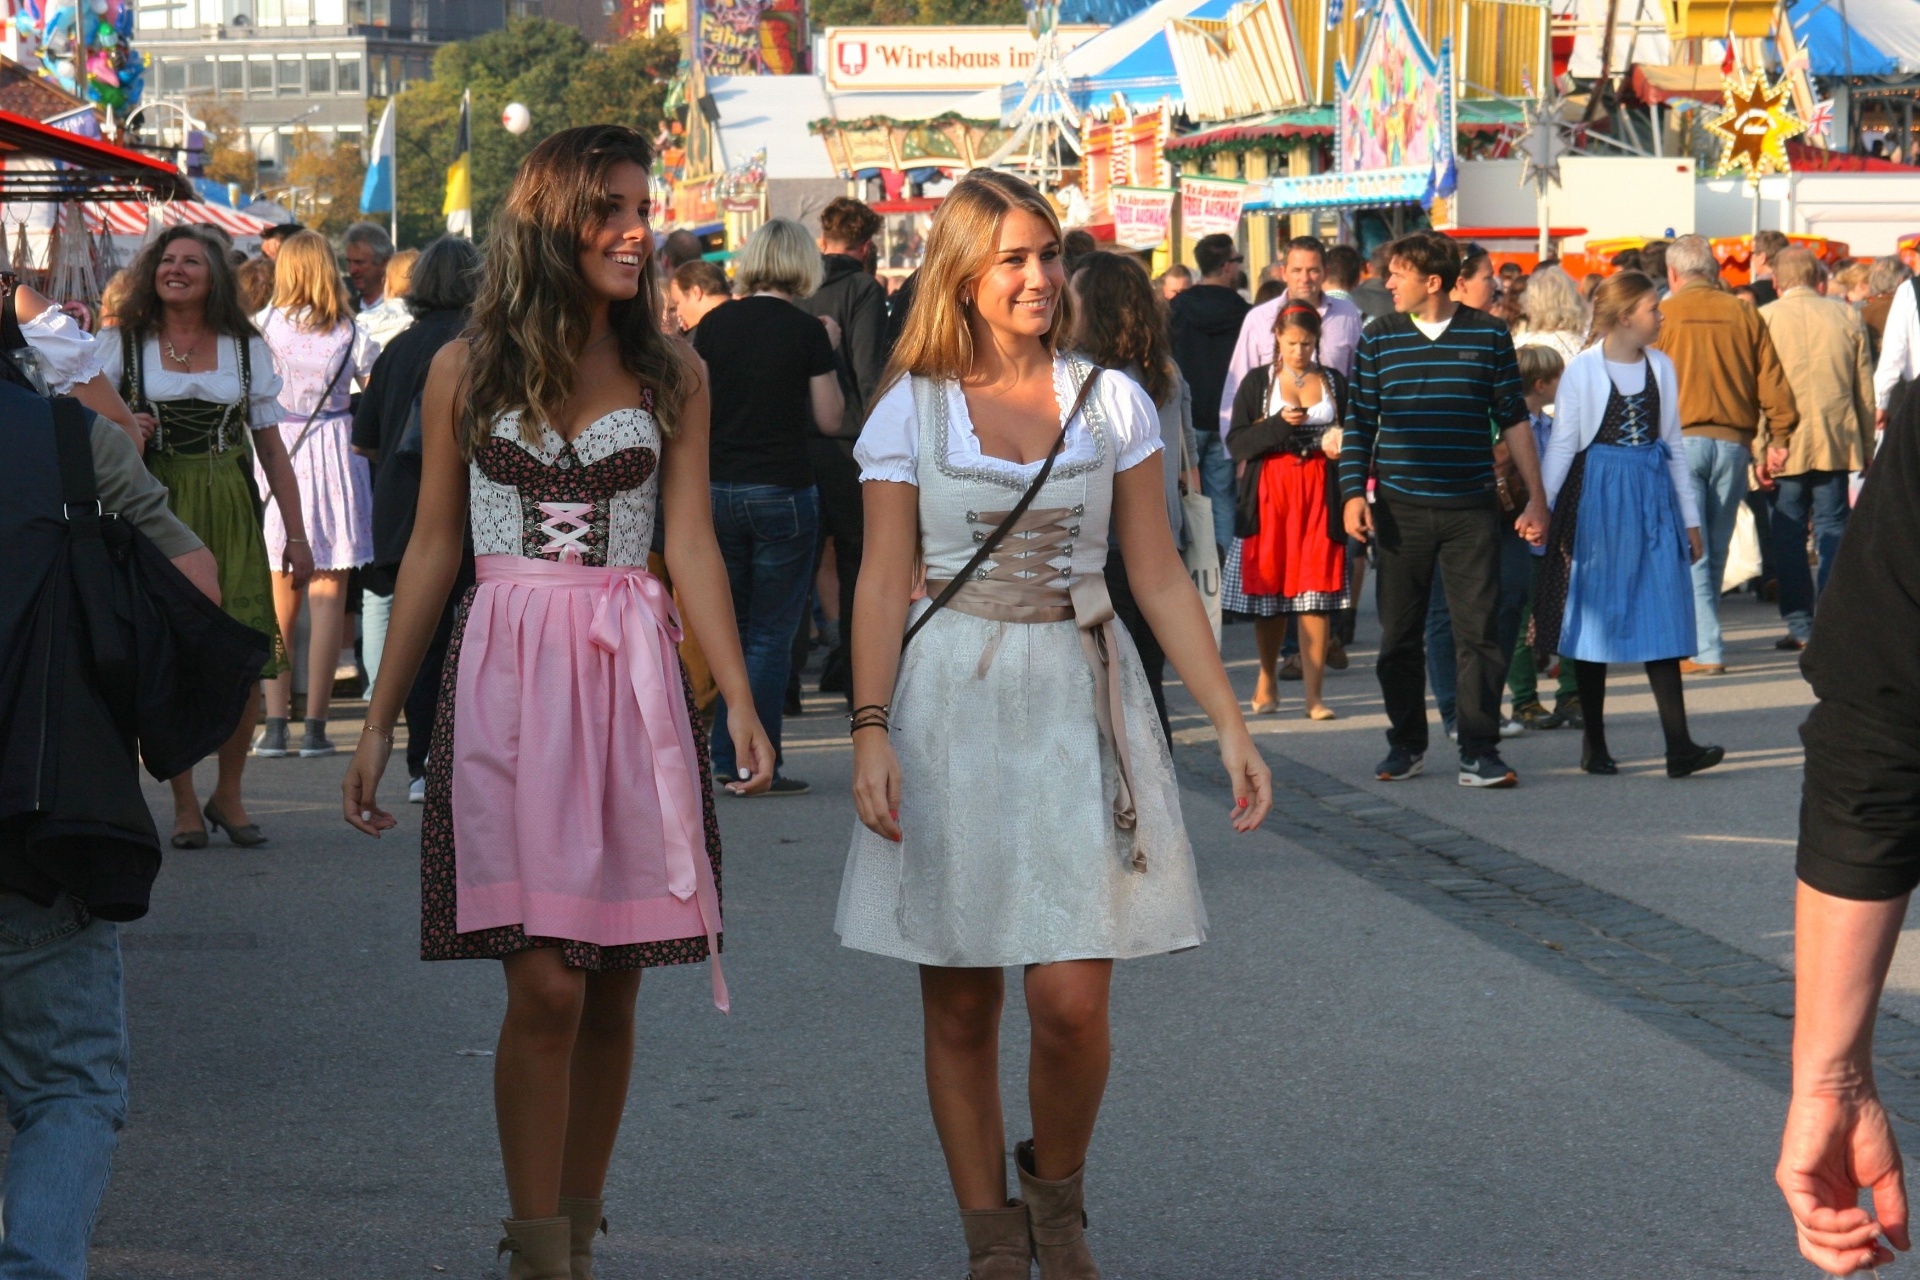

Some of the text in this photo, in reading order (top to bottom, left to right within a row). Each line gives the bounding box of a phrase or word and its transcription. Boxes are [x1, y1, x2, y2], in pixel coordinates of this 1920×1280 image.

[701, 11, 759, 51] Fahrt
[717, 50, 742, 66] zur
[876, 45, 1000, 70] Wirtshaus
